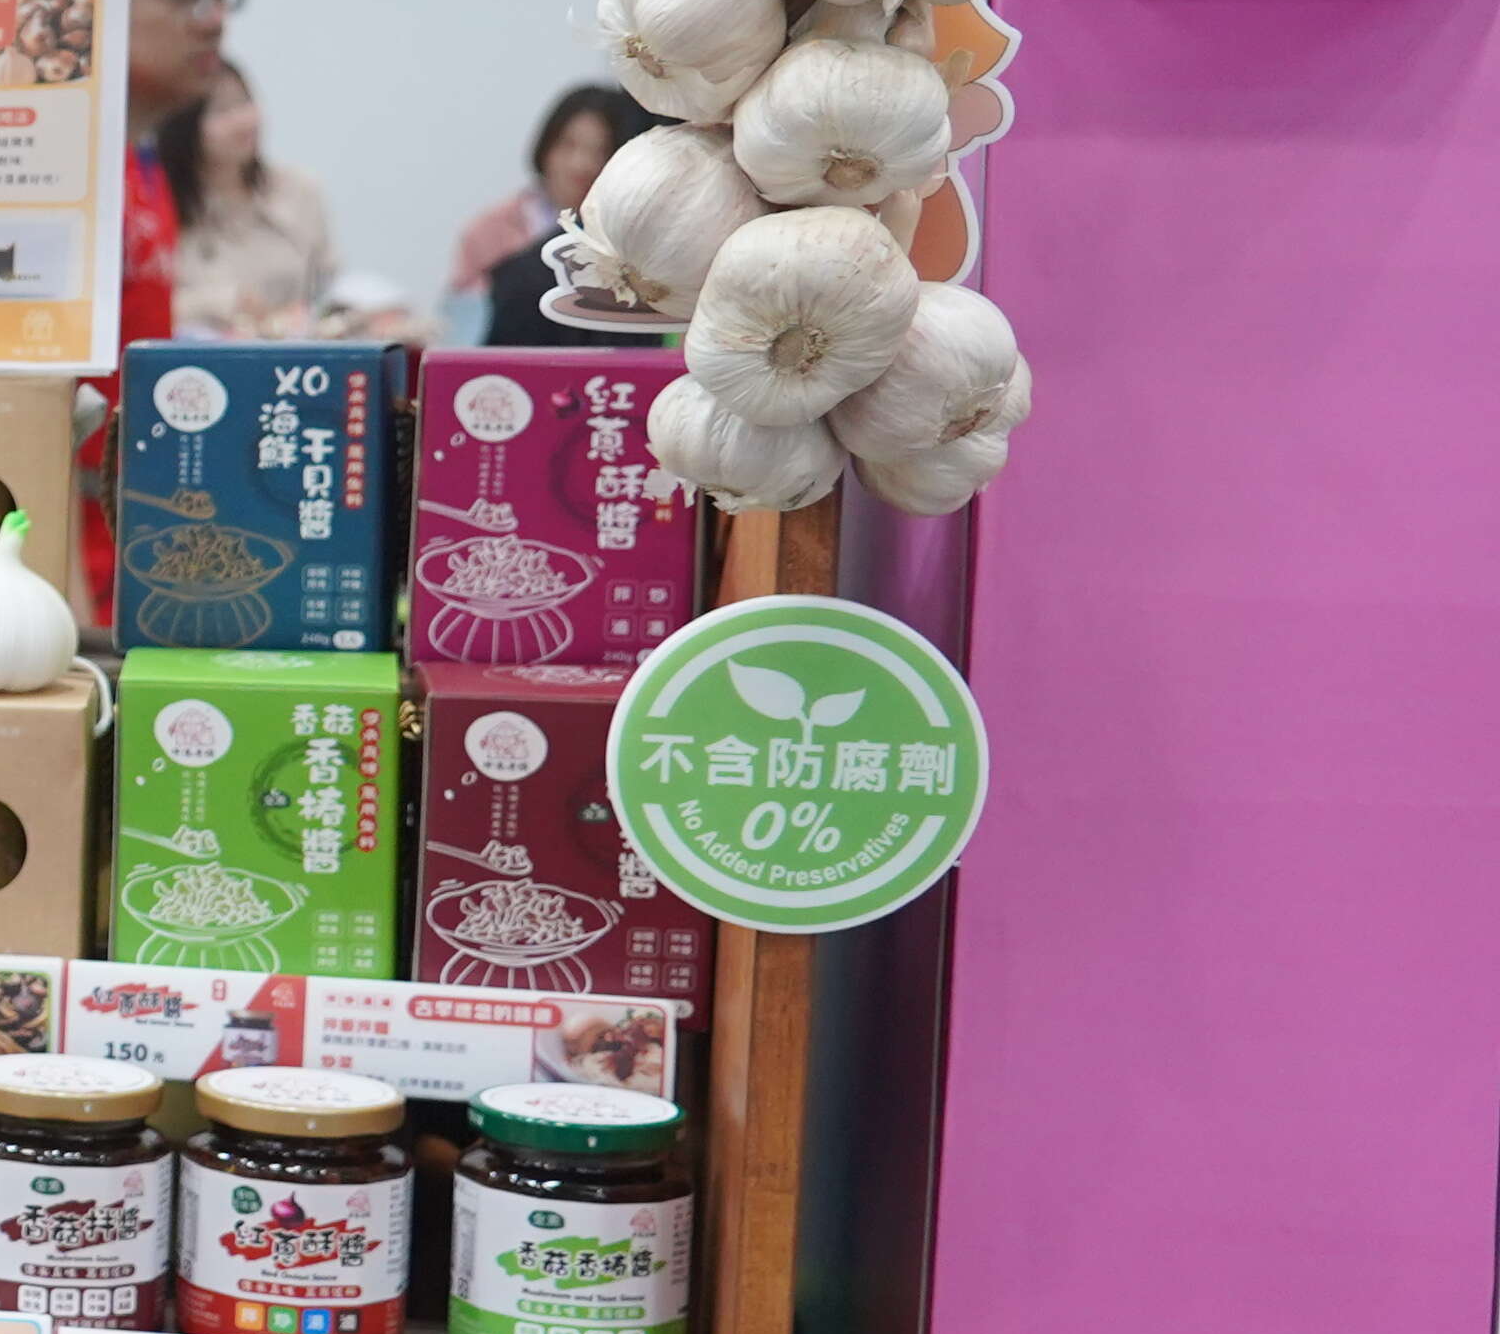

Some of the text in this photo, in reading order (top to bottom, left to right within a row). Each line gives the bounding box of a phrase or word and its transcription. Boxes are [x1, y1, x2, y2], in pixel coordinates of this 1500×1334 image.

[274, 366, 330, 397] XO
[639, 733, 958, 796] 不含防腐劑
[677, 798, 911, 888] No Added Preservatives
[740, 800, 841, 853] 0%
[103, 1042, 148, 1062] 150
[21, 1204, 138, 1249] 香菇拌醬
[233, 1217, 367, 1269] 紅蔥酥醬
